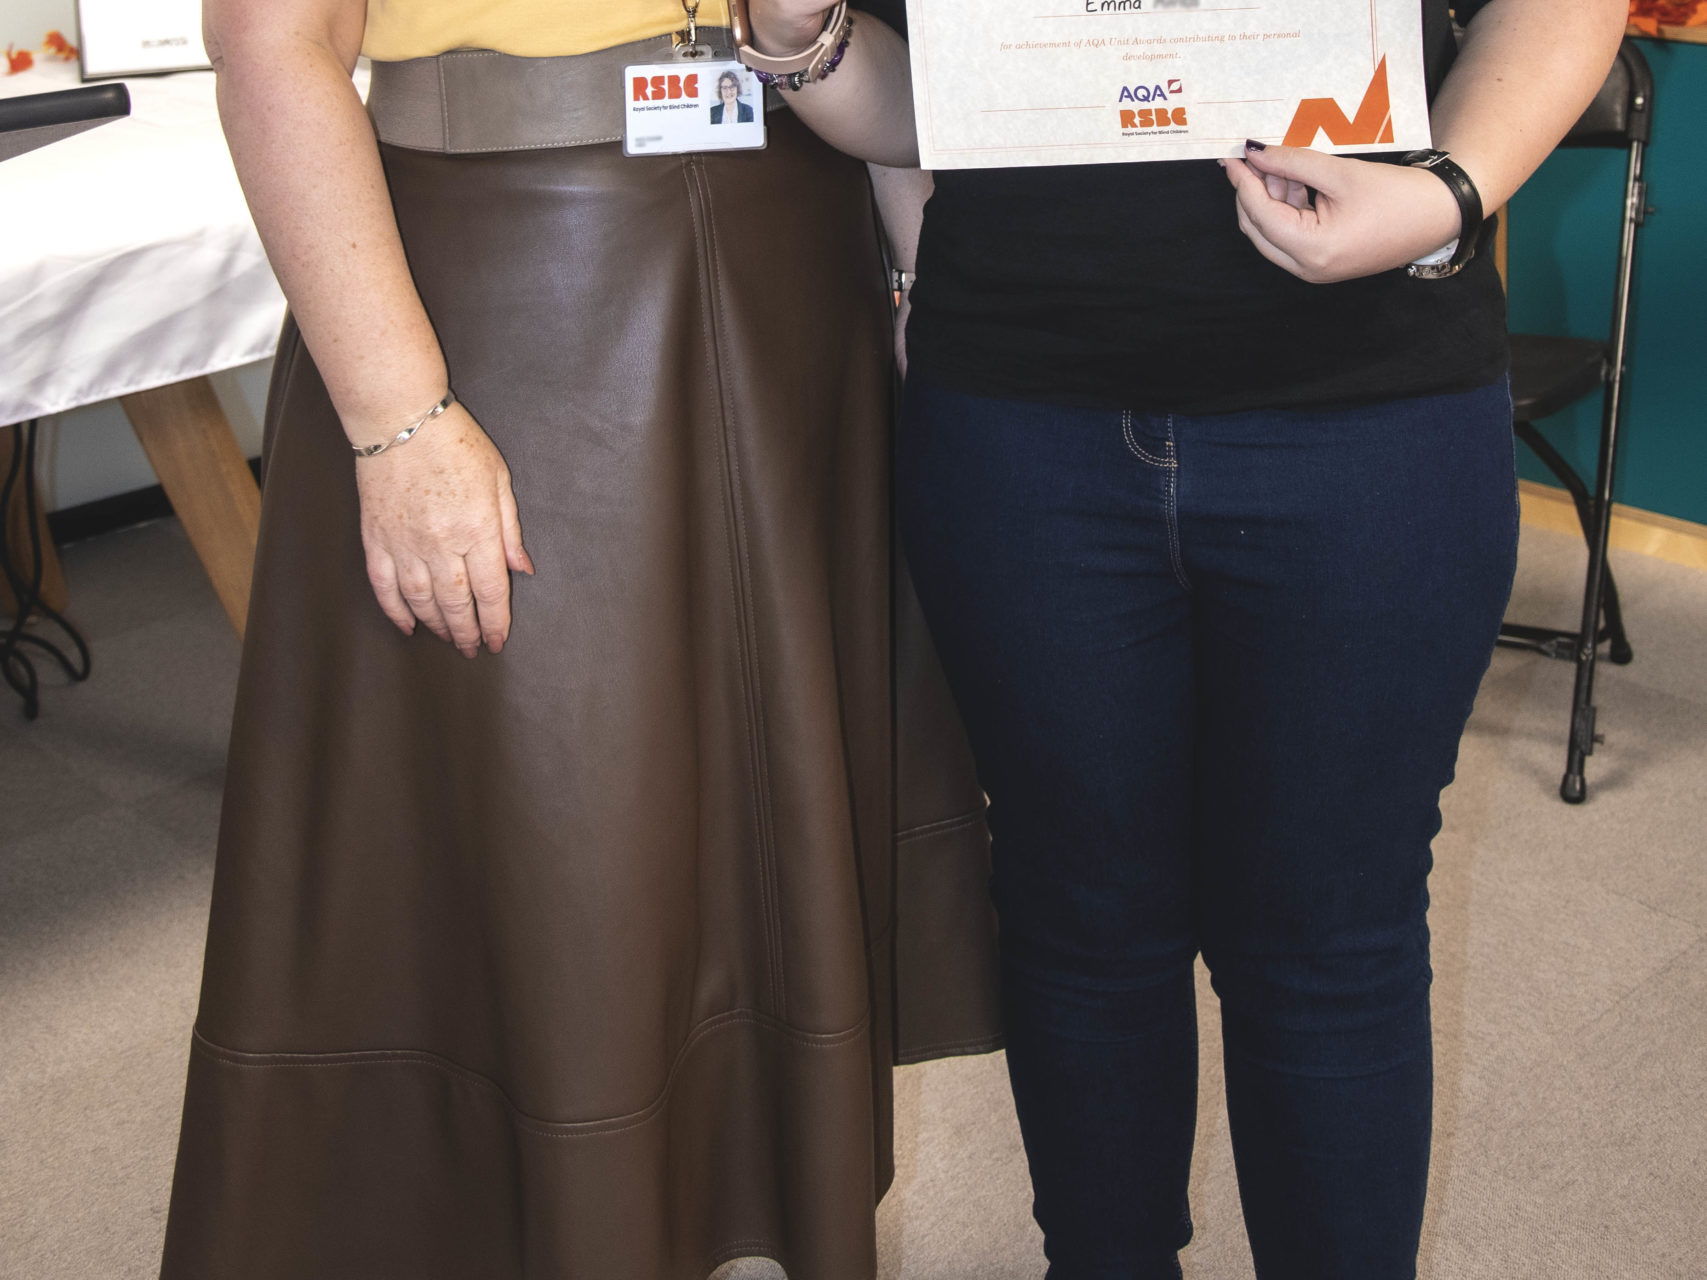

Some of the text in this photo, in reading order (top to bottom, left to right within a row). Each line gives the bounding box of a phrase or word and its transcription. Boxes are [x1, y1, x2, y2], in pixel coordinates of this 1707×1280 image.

[1000, 42, 1013, 51] for
[1015, 41, 1071, 50] achievement
[1073, 40, 1082, 49] of
[1084, 38, 1107, 48] AQA
[1109, 37, 1130, 46] Unit
[1132, 36, 1167, 45] Awards
[1169, 34, 1226, 43] contributing
[1239, 32, 1261, 40] their
[1262, 29, 1301, 41] personal
[1122, 52, 1182, 62] development.
[632, 74, 699, 101] RSBC
[1118, 84, 1168, 103] AQA
[1119, 107, 1188, 129] RSBC
